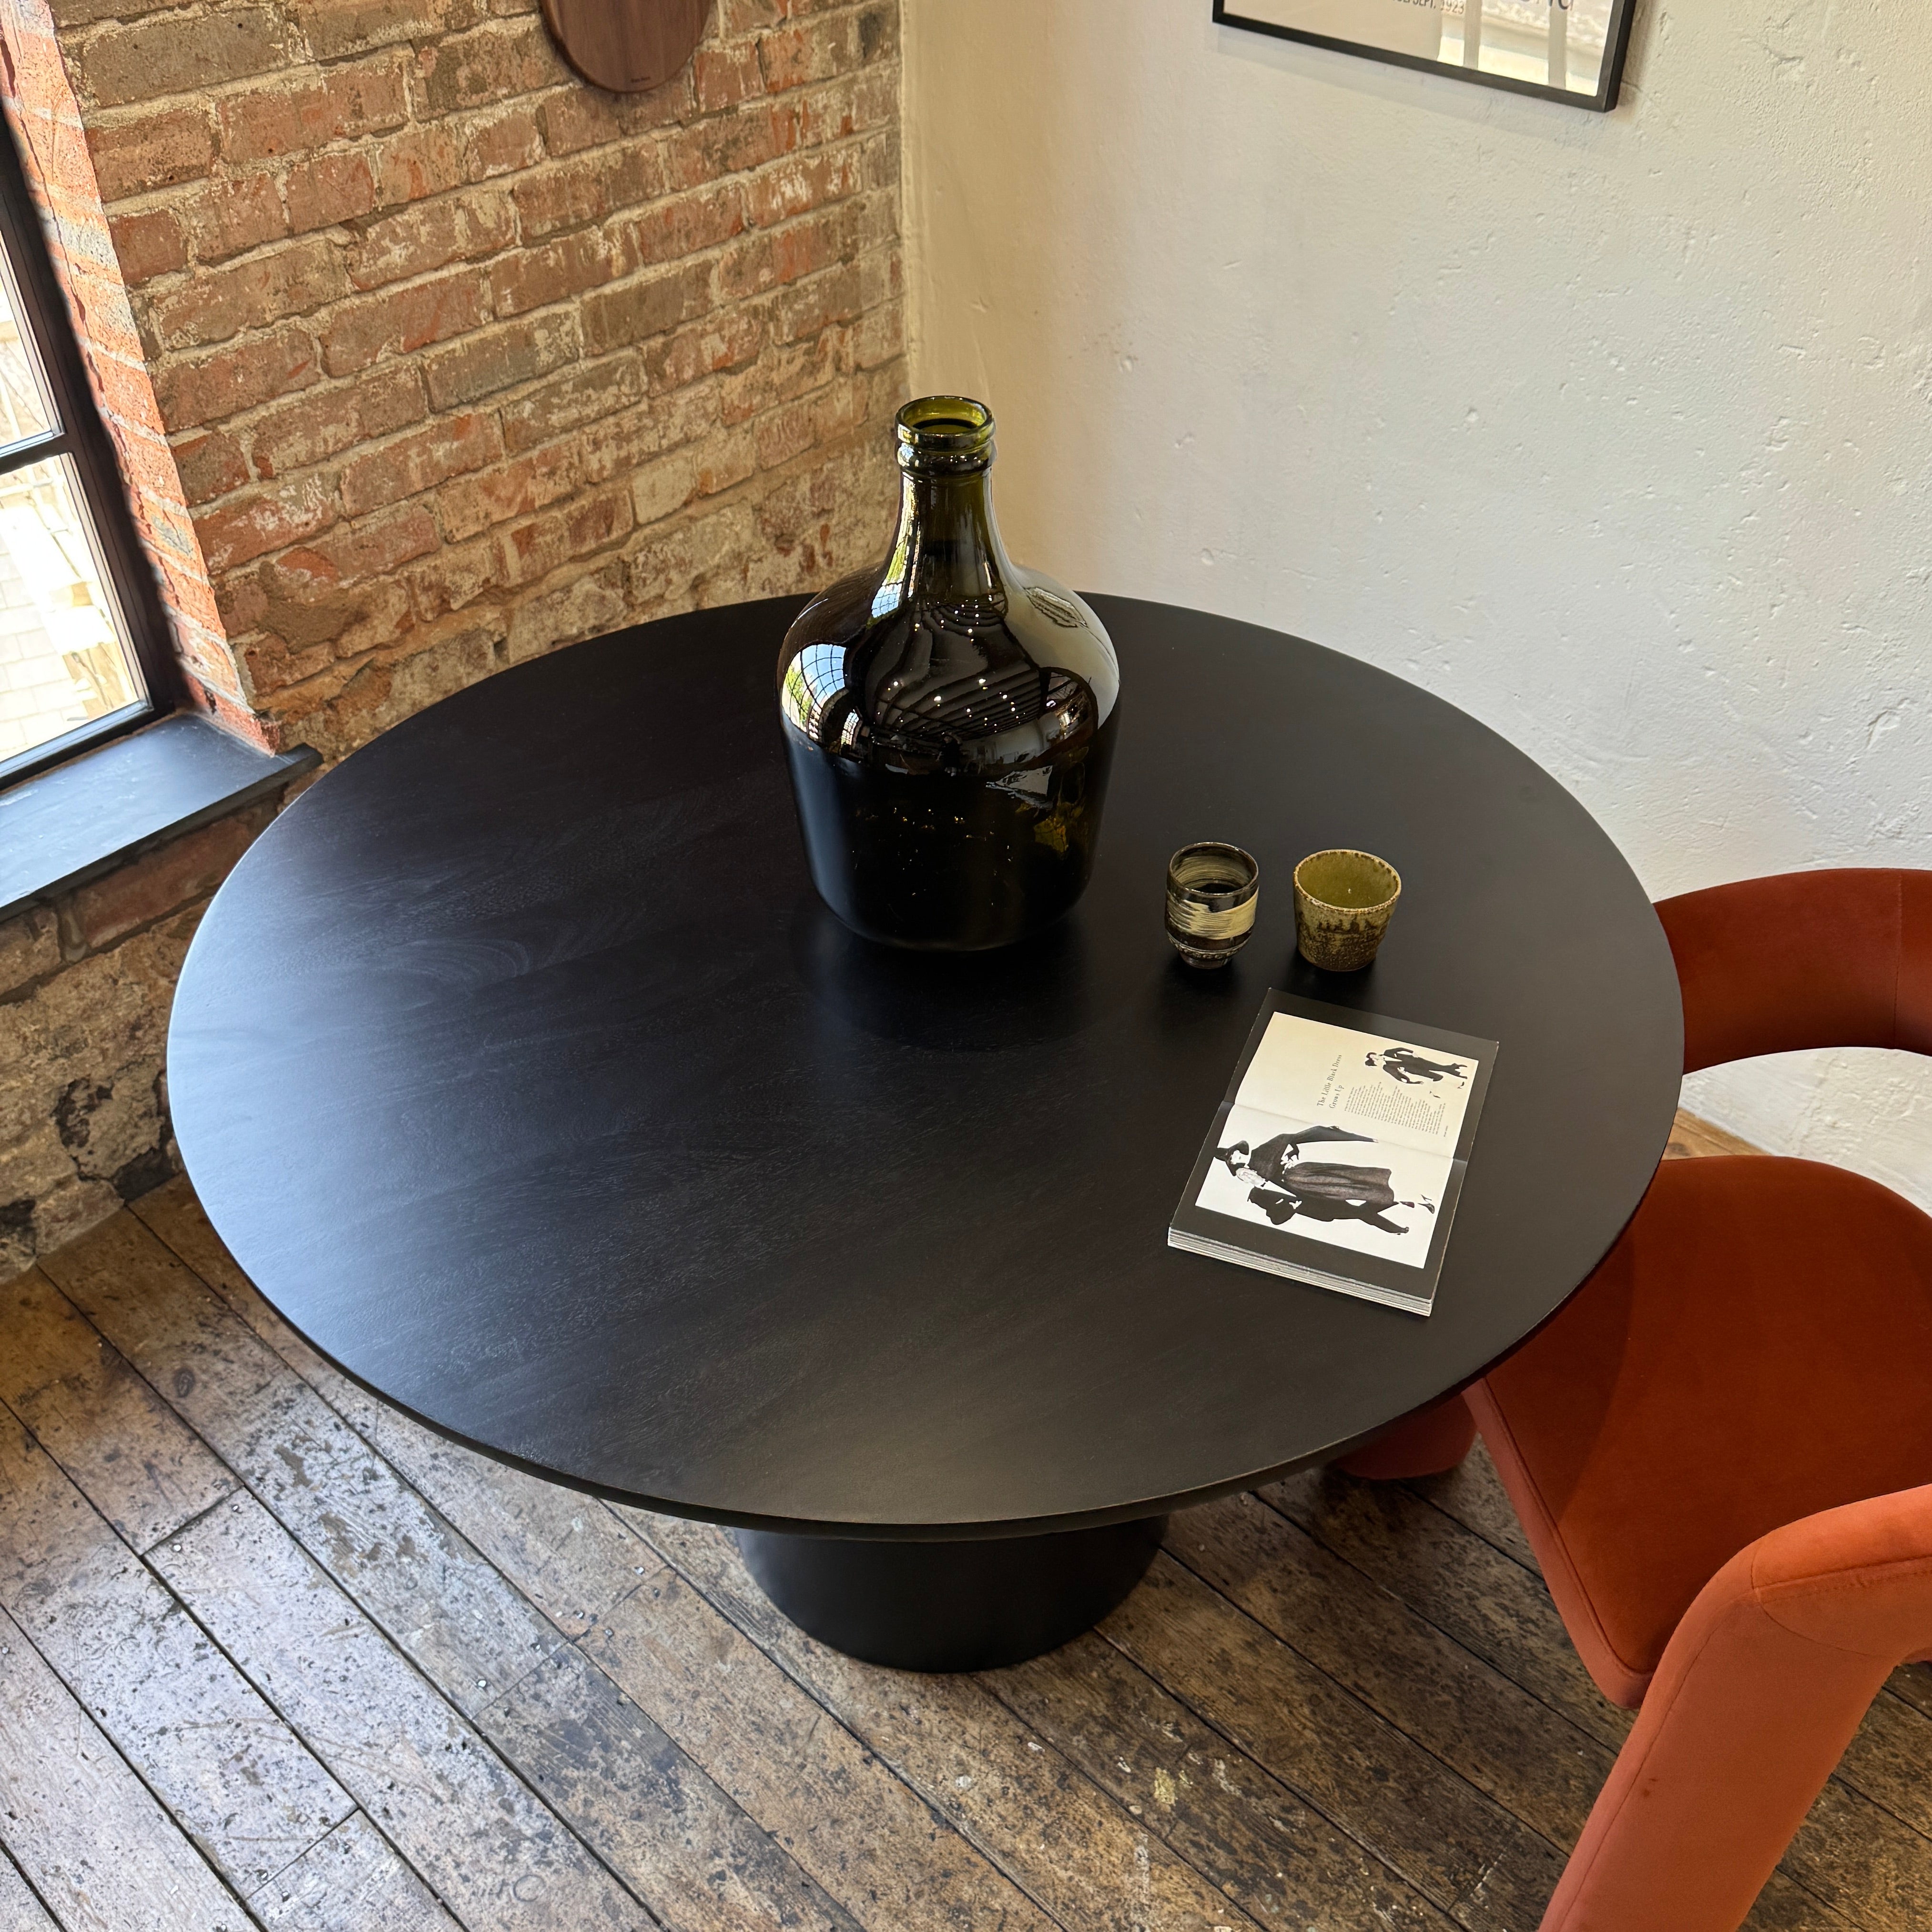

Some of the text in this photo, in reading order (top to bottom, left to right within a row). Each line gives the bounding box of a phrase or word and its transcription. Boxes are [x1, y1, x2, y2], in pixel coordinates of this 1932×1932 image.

[1441, 0, 1464, 14] 1923
[1317, 1055, 1342, 1106] The Little Black Dress
